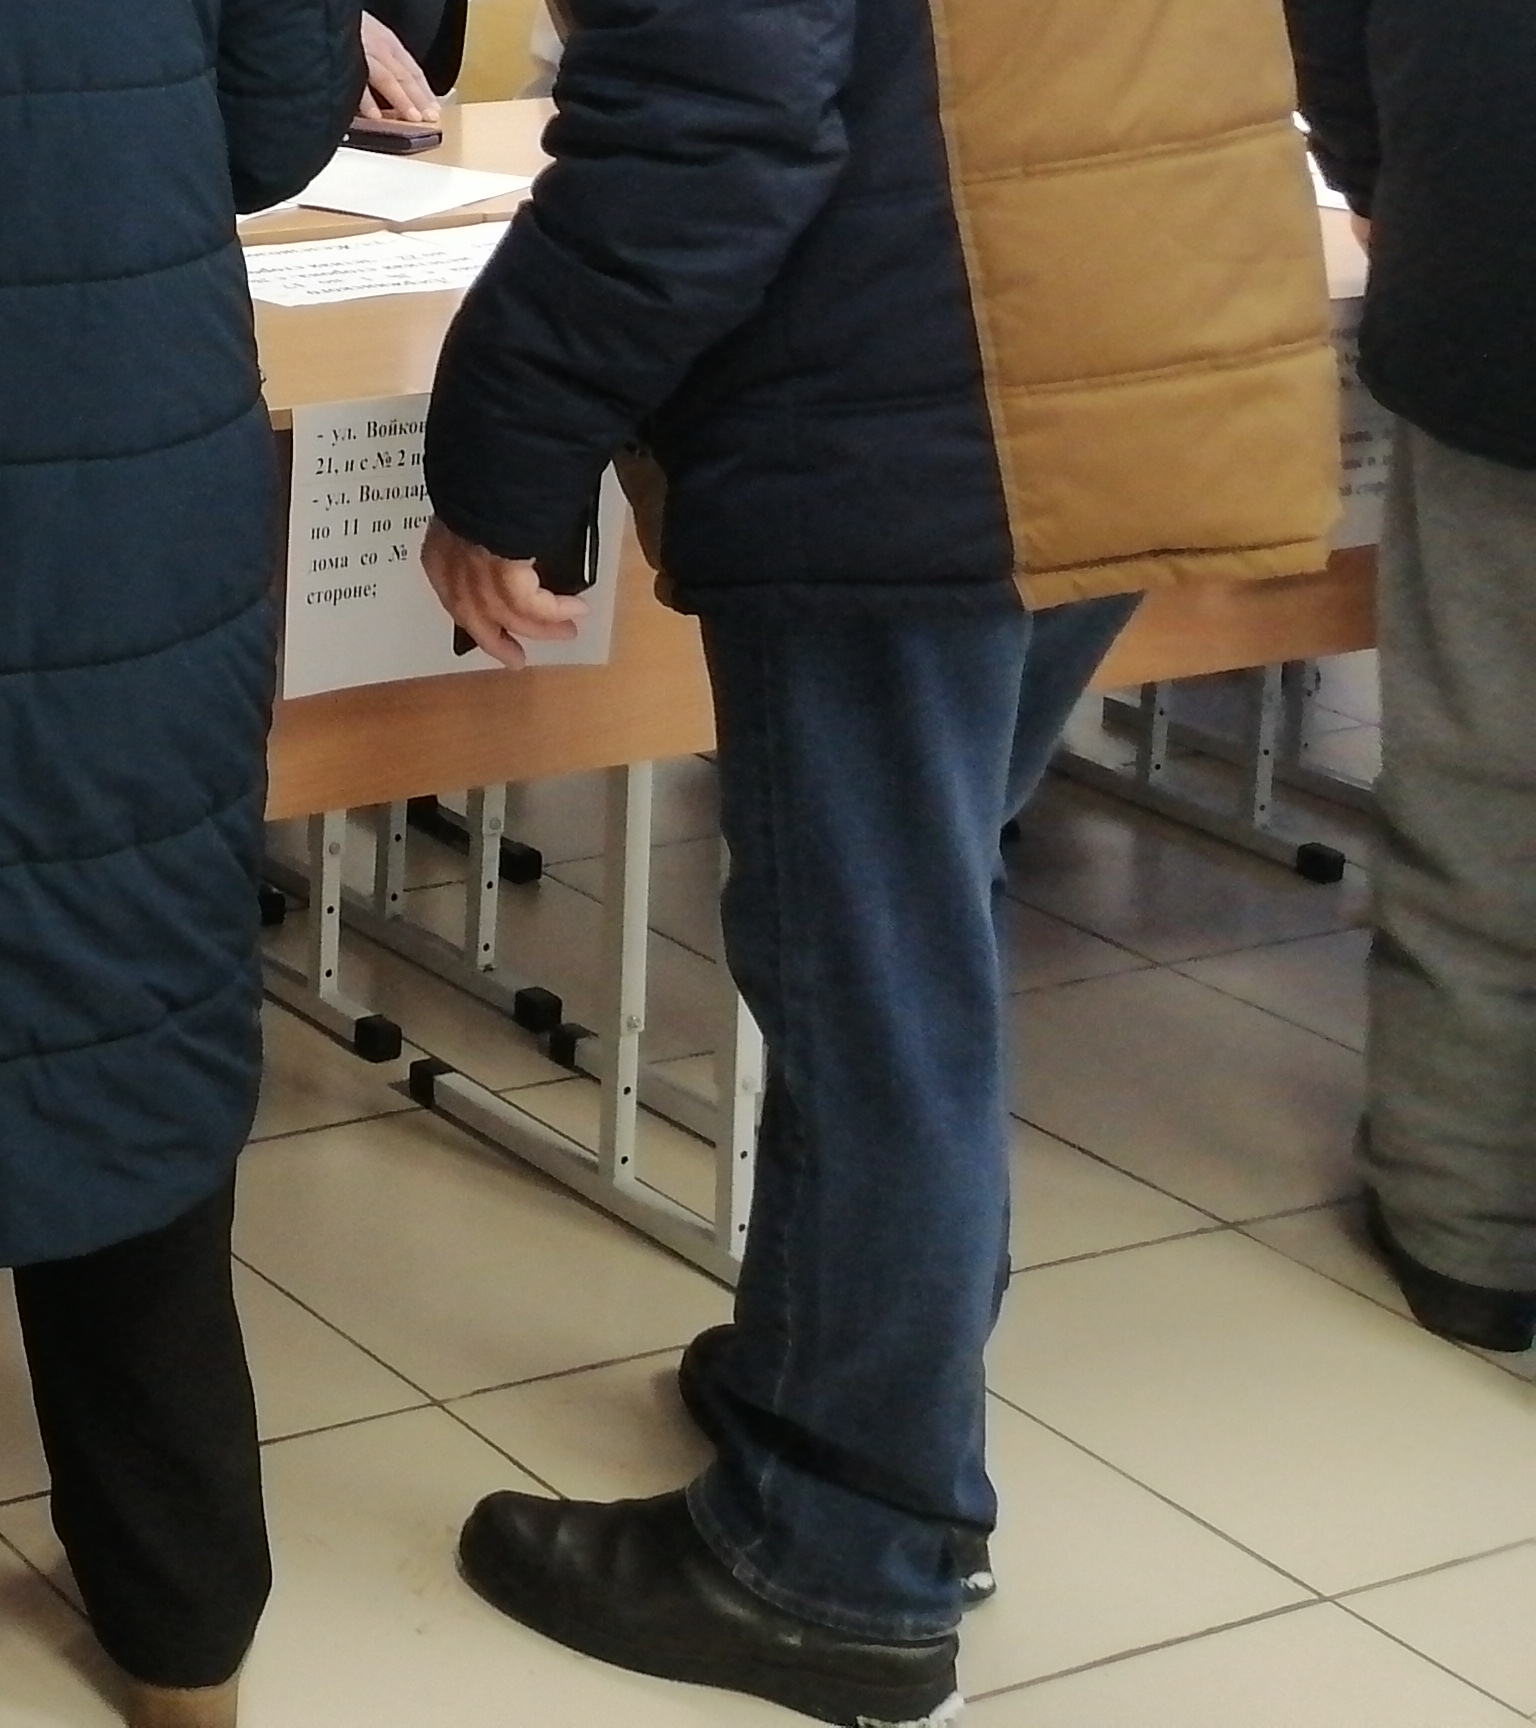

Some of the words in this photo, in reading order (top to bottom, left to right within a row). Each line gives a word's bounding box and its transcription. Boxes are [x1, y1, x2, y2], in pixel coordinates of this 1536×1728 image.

[331, 427, 357, 447] ул.
[315, 456, 339, 476] 21,
[359, 456, 369, 471] с
[372, 450, 393, 470] №
[397, 448, 406, 467] 2
[325, 492, 351, 512] ул.
[311, 525, 331, 540] по
[343, 517, 359, 536] 11
[371, 518, 392, 533] по
[308, 554, 349, 574] дома
[360, 551, 378, 566] со
[388, 542, 408, 563] №
[306, 583, 377, 607] стороне;
